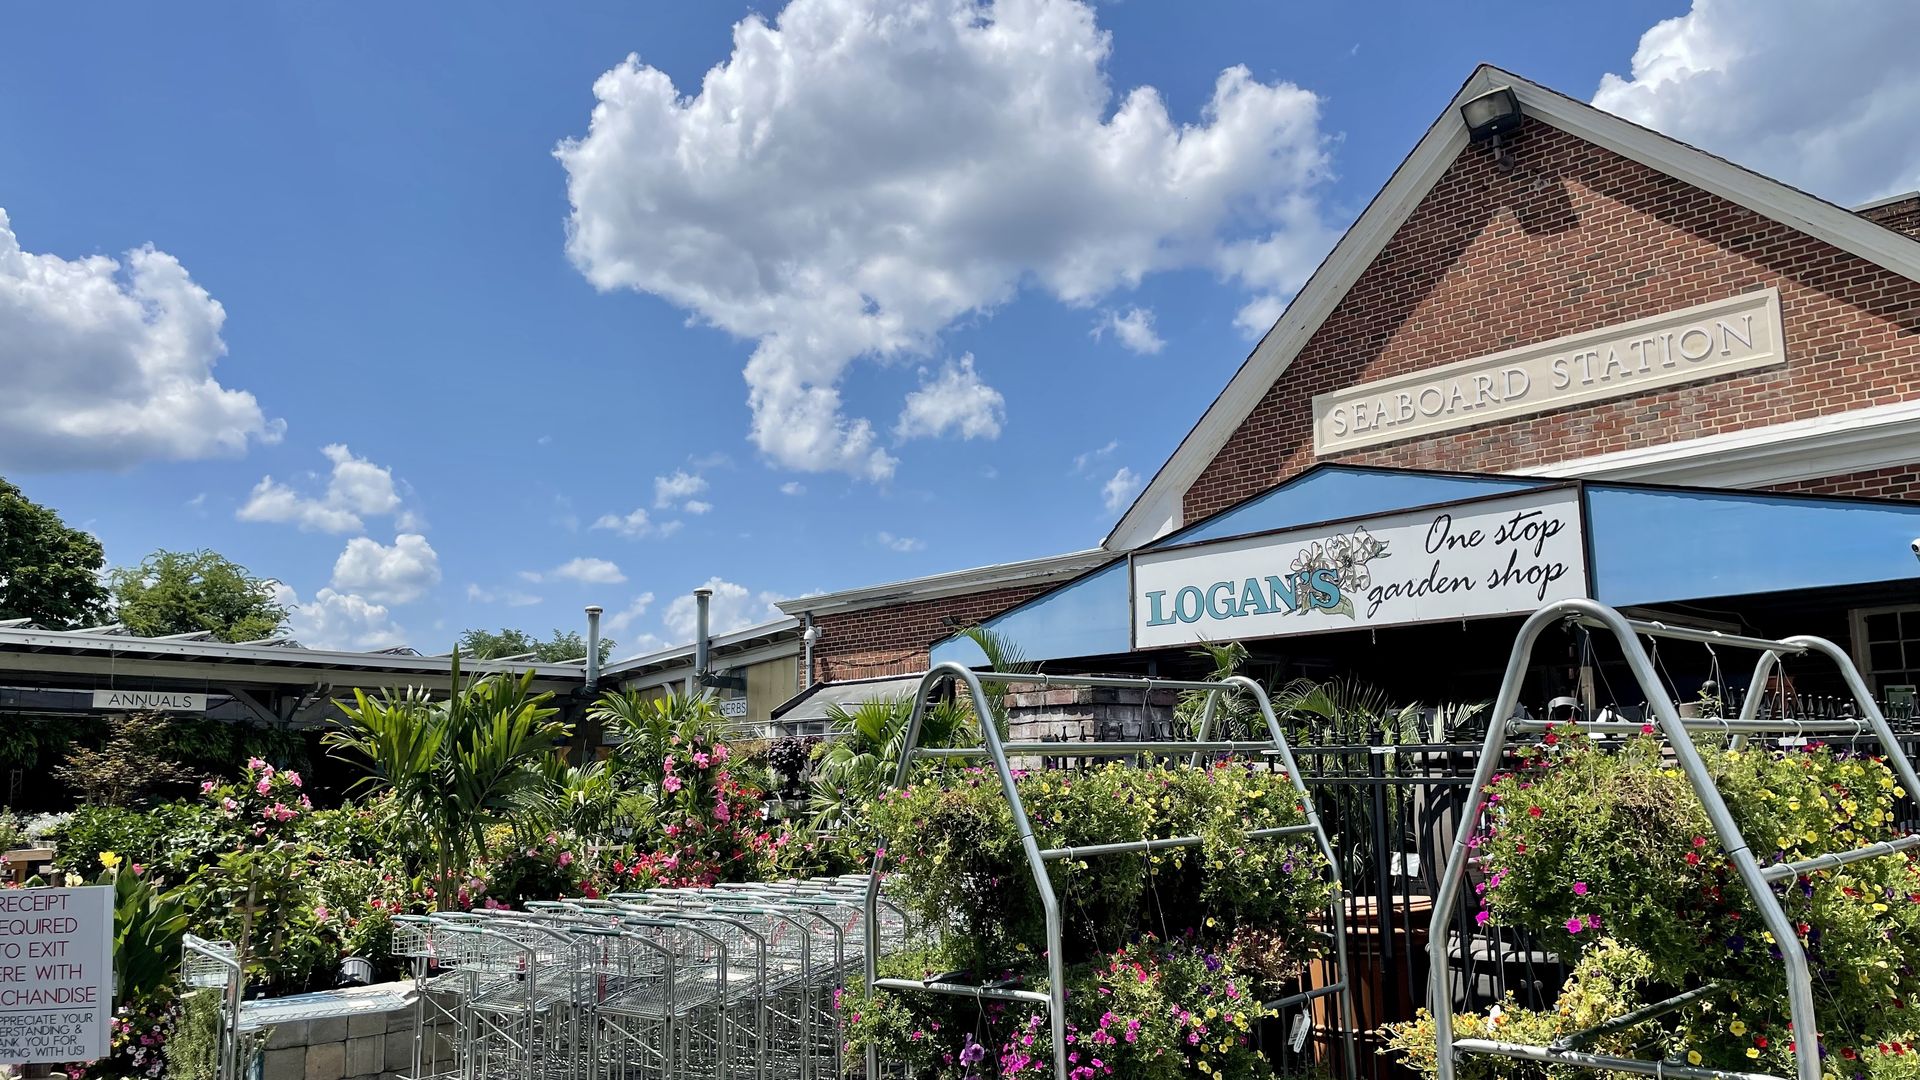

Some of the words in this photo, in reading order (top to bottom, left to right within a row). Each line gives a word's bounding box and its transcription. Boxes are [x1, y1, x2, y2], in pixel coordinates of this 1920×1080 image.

[1332, 366, 1530, 437] SEABOARD
[1551, 314, 1755, 390] STATION
[1425, 514, 1485, 554] One
[1495, 510, 1566, 558] stop
[1367, 565, 1476, 619] garden
[1486, 549, 1569, 600] shop
[1145, 568, 1342, 627] LOGAN'S
[108, 693, 192, 708] ANNUALS
[720, 702, 746, 715] HERBS
[0, 894, 71, 912] RECEIPT
[29, 940, 70, 958] EXIT
[35, 963, 82, 981] WITH
[62, 1012, 94, 1024] YOUR
[74, 1024, 82, 1034] &
[25, 1036, 49, 1047] YOU
[53, 1035, 77, 1046] FOR
[35, 1046, 64, 1057] WITH
[68, 1045, 85, 1056] US!
